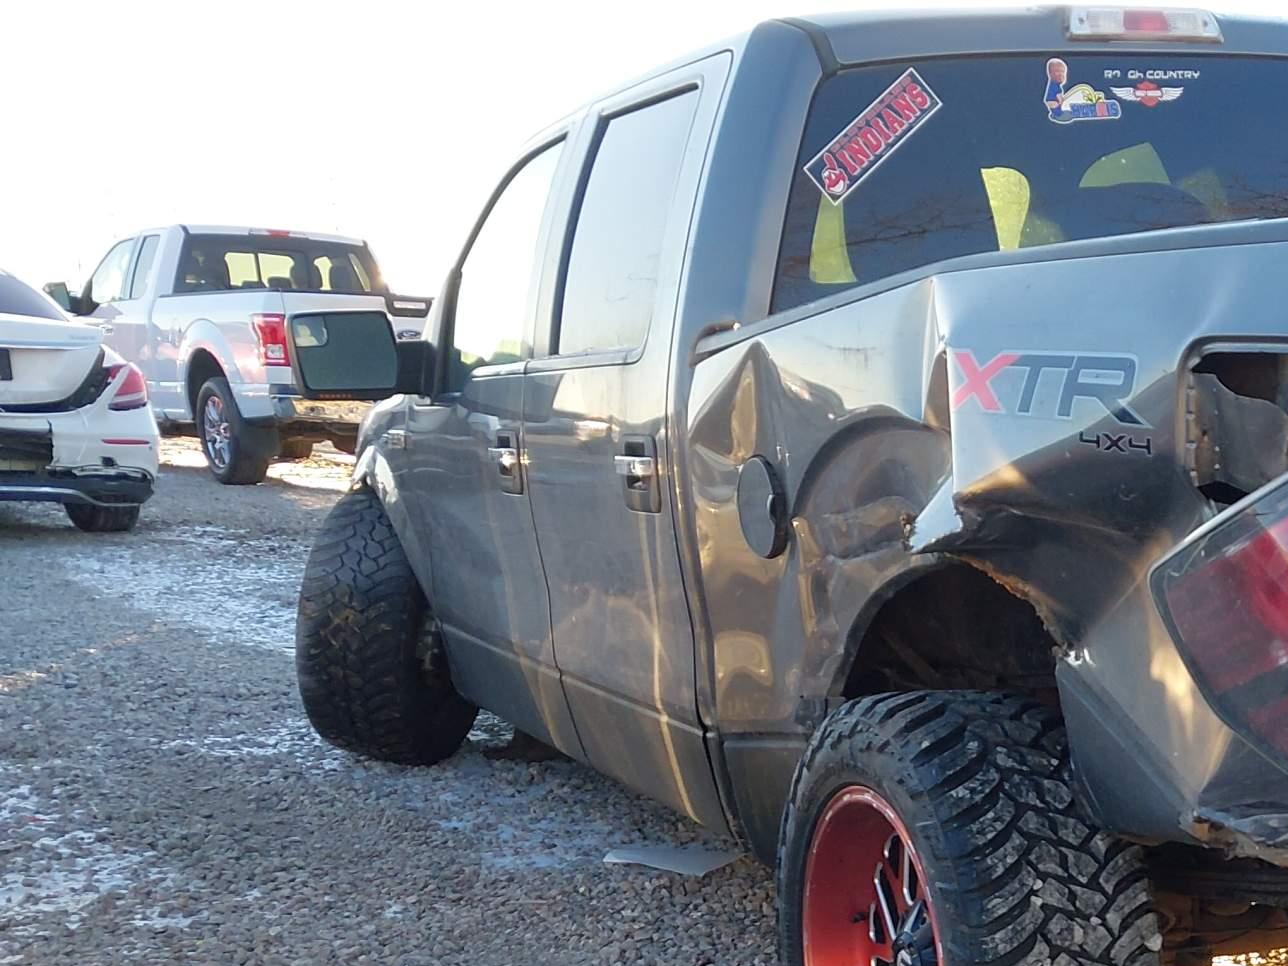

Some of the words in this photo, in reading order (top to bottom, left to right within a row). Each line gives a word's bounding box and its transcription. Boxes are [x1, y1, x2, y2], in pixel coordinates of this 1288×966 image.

[1146, 69, 1201, 80] COUNTRY
[836, 82, 931, 176] INDIANS
[951, 349, 1152, 428] XTR
